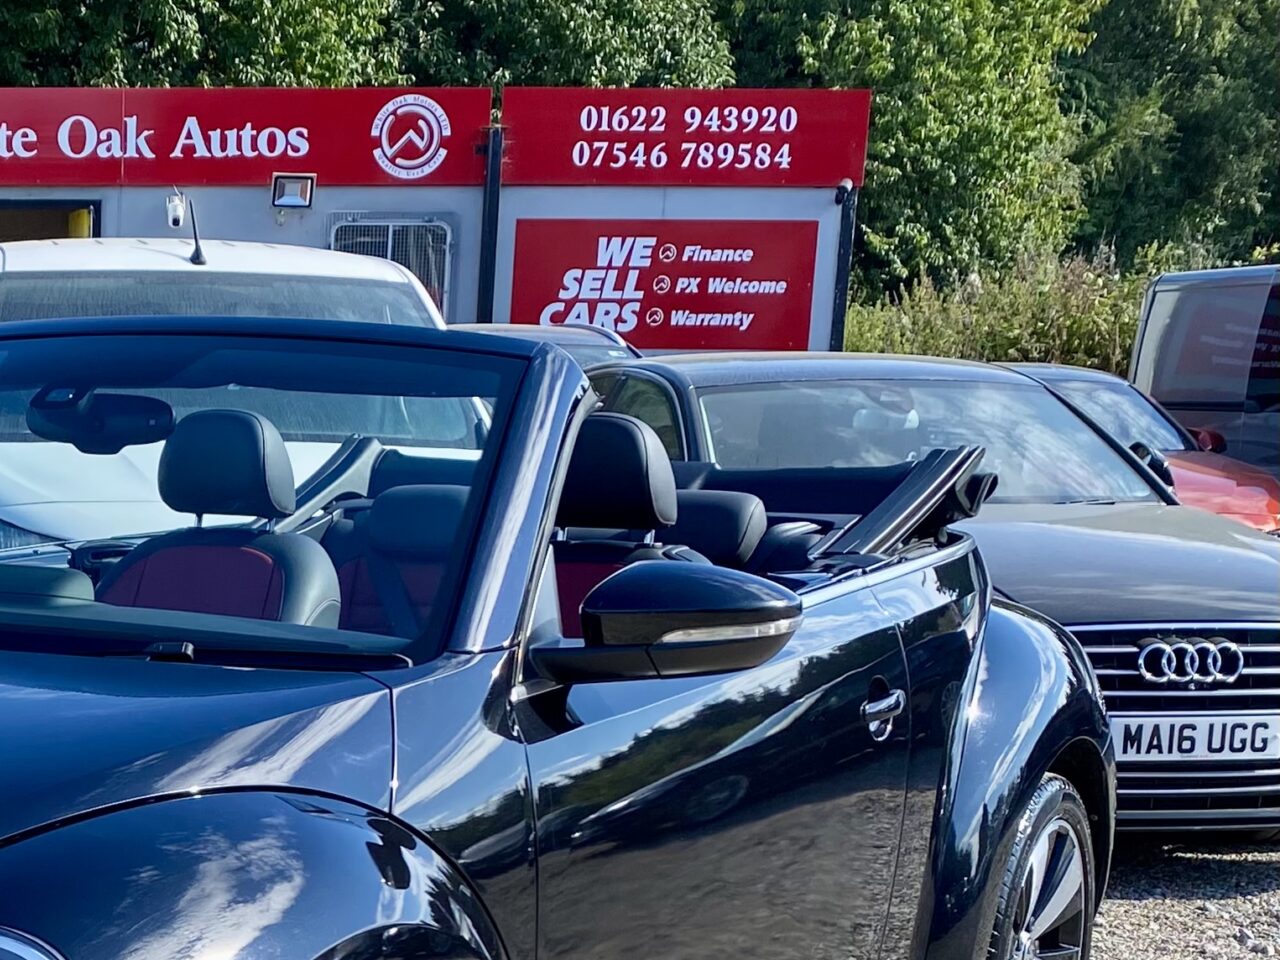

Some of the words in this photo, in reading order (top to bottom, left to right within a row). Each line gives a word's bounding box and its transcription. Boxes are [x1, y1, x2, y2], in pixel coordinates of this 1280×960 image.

[580, 105, 667, 132] 01622
[683, 106, 798, 133] 943920
[57, 114, 156, 159] Oak
[170, 116, 310, 158] Autos
[571, 141, 668, 168] 07546
[680, 142, 792, 169] 789584
[596, 236, 657, 268] WE
[681, 245, 754, 263] Finance
[558, 269, 645, 300] SELL
[674, 277, 701, 293] PX
[707, 277, 787, 294] Welcome
[539, 302, 641, 333] CARS
[670, 310, 754, 331] Warranty
[1122, 723, 1198, 755] MA16
[1207, 722, 1269, 754] UGG
